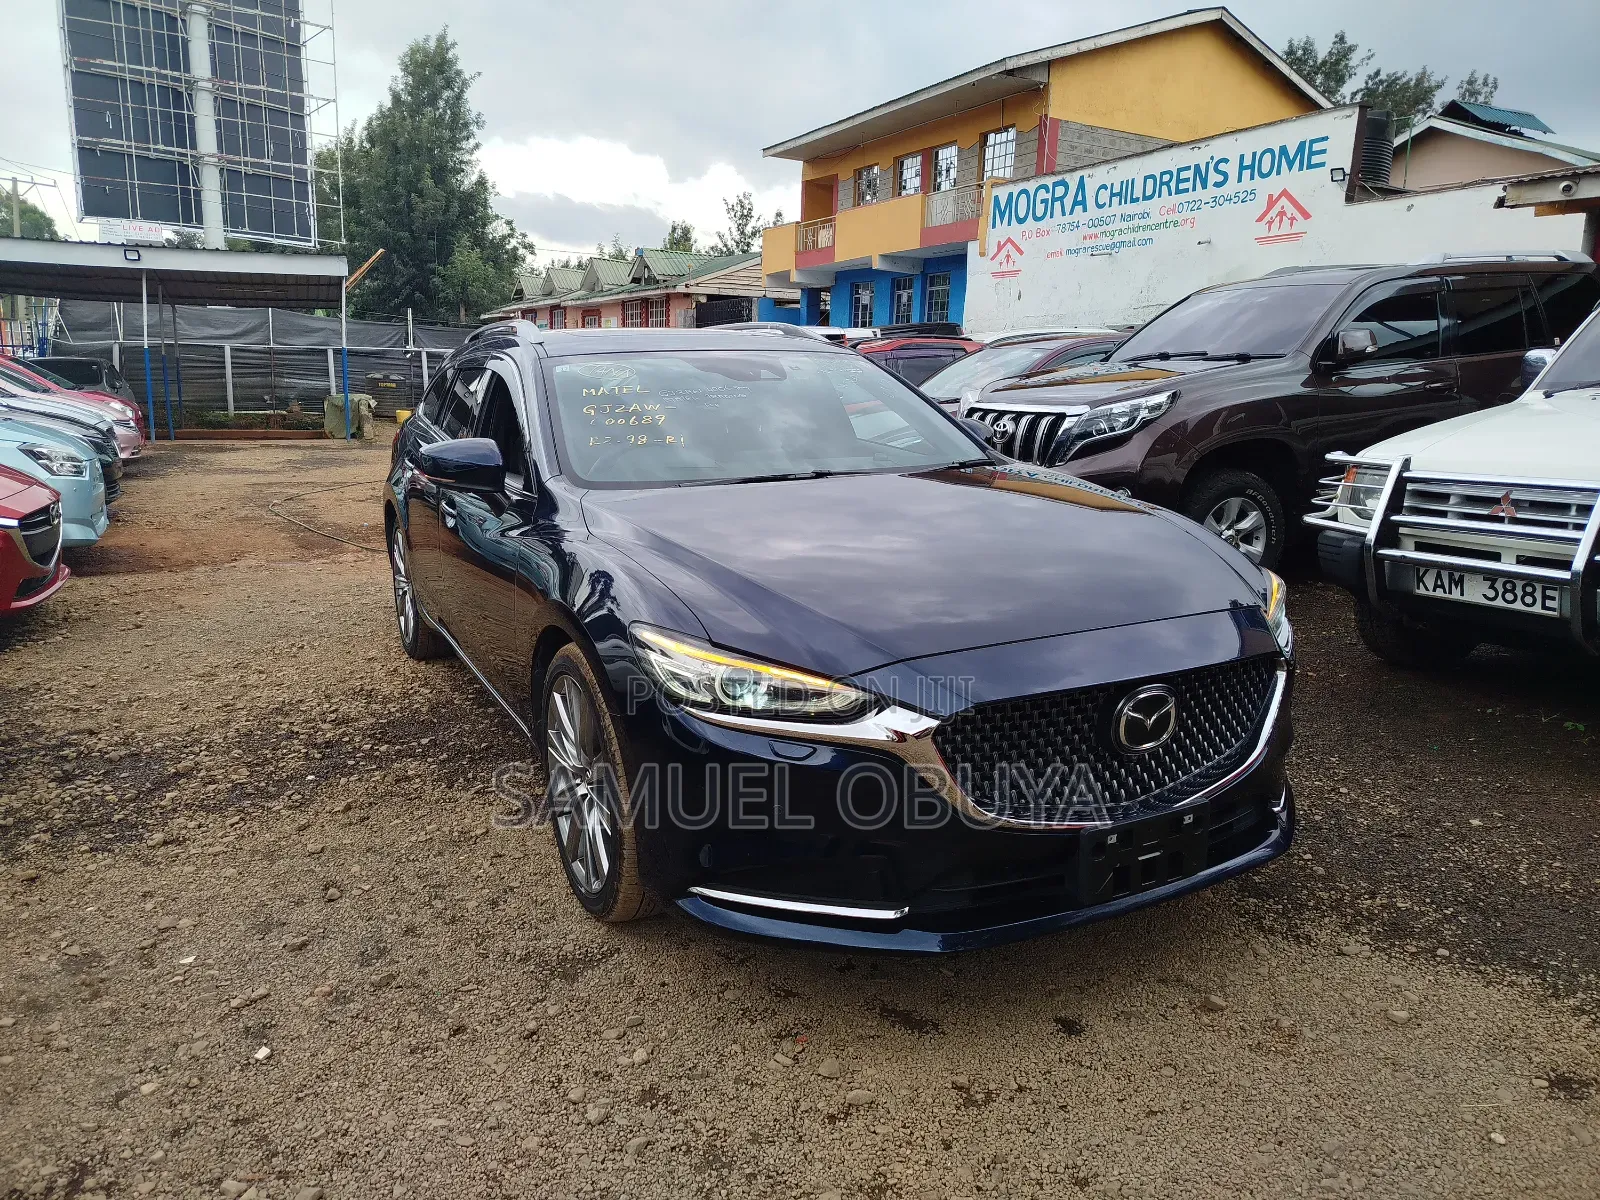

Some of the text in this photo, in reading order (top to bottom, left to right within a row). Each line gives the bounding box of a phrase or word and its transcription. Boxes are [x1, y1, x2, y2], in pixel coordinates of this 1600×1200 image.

[991, 135, 1329, 229] MOGRA CHILDREN'S HOME
[122, 224, 143, 232] LIVE
[1035, 227, 1051, 238] Box
[1056, 214, 1117, 234] 78754-00507
[1245, 488, 1277, 544] BFGoodrich
[1415, 568, 1558, 613] KAM 388E
